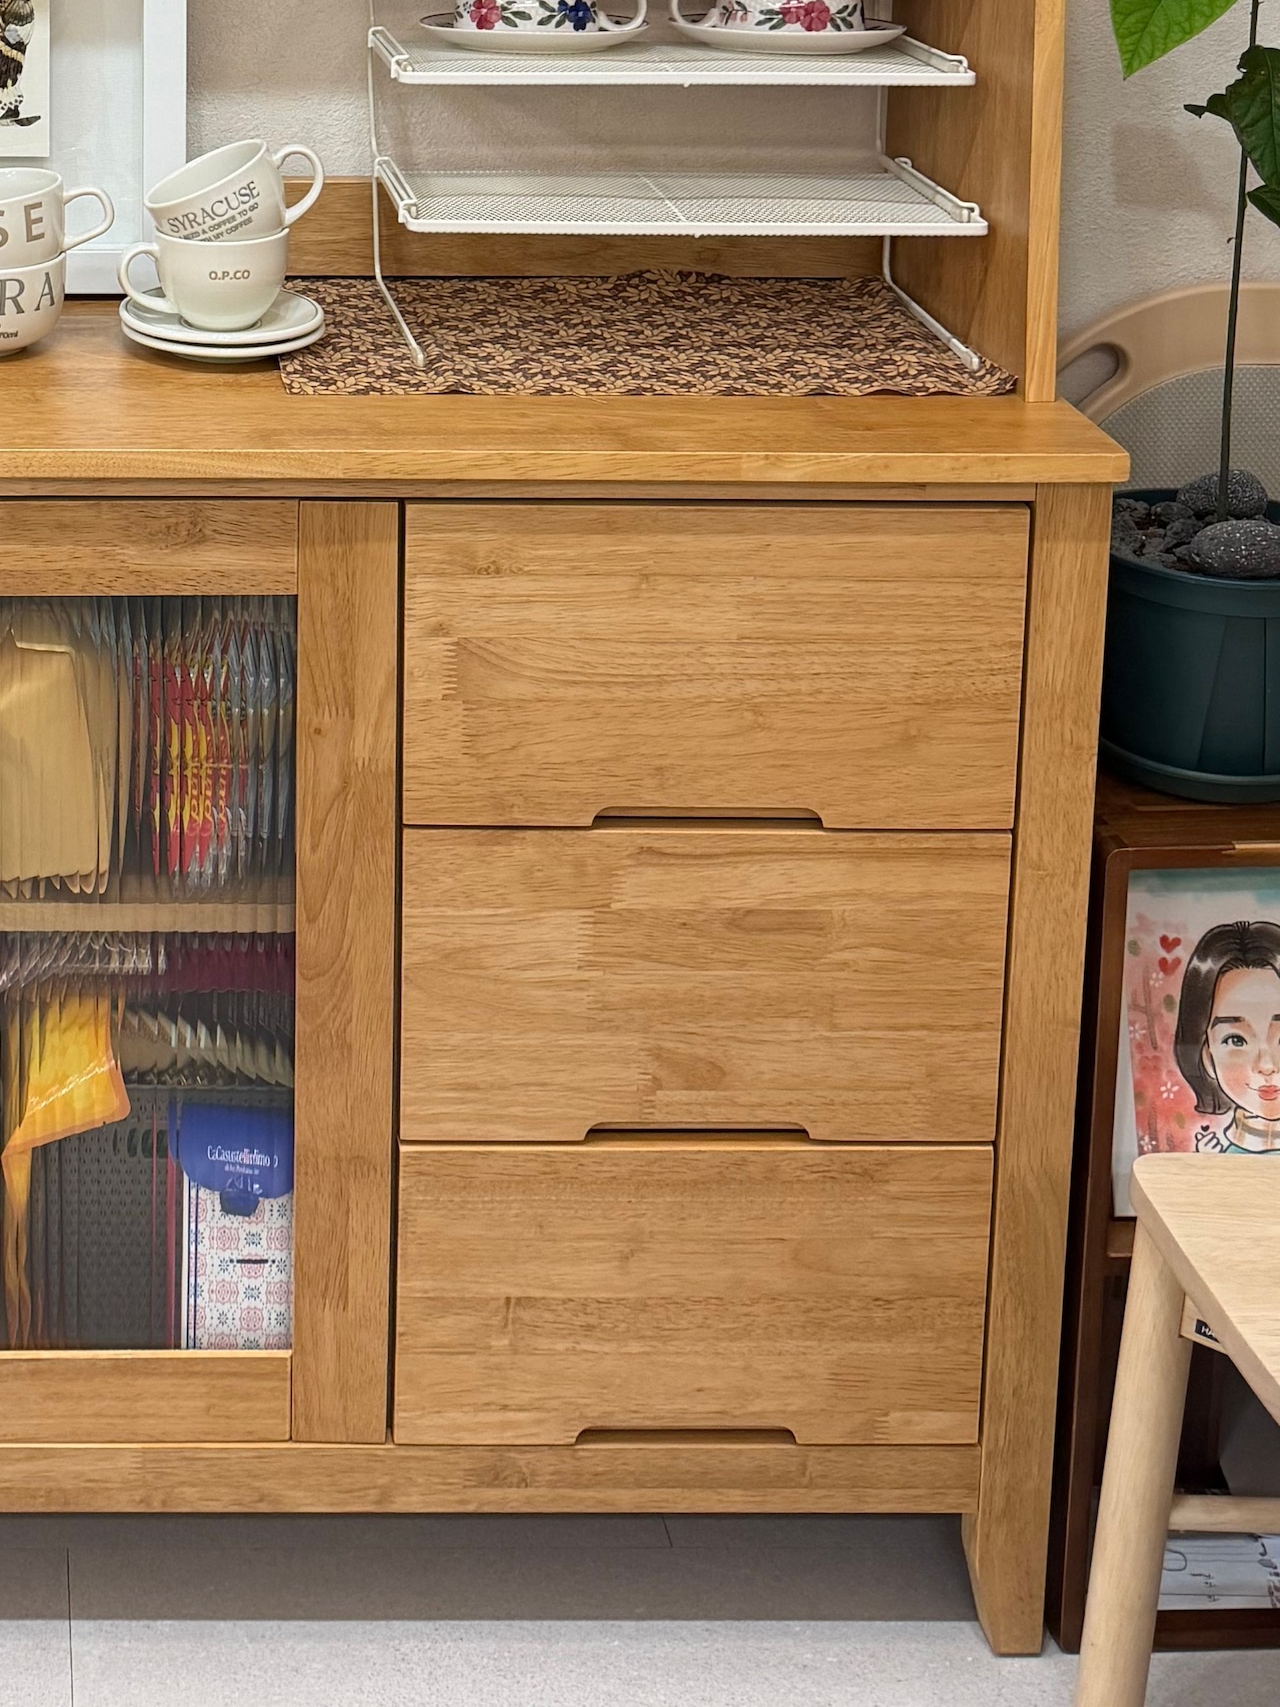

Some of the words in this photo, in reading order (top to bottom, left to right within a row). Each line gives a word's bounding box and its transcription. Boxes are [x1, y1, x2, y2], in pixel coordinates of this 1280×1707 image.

[166, 180, 261, 234] SYRACUSE
[208, 215, 237, 232] COFFEE
[238, 209, 248, 218] TO
[249, 202, 259, 212] GO
[225, 217, 253, 235] COFFEE
[208, 269, 251, 281] O.P.CO
